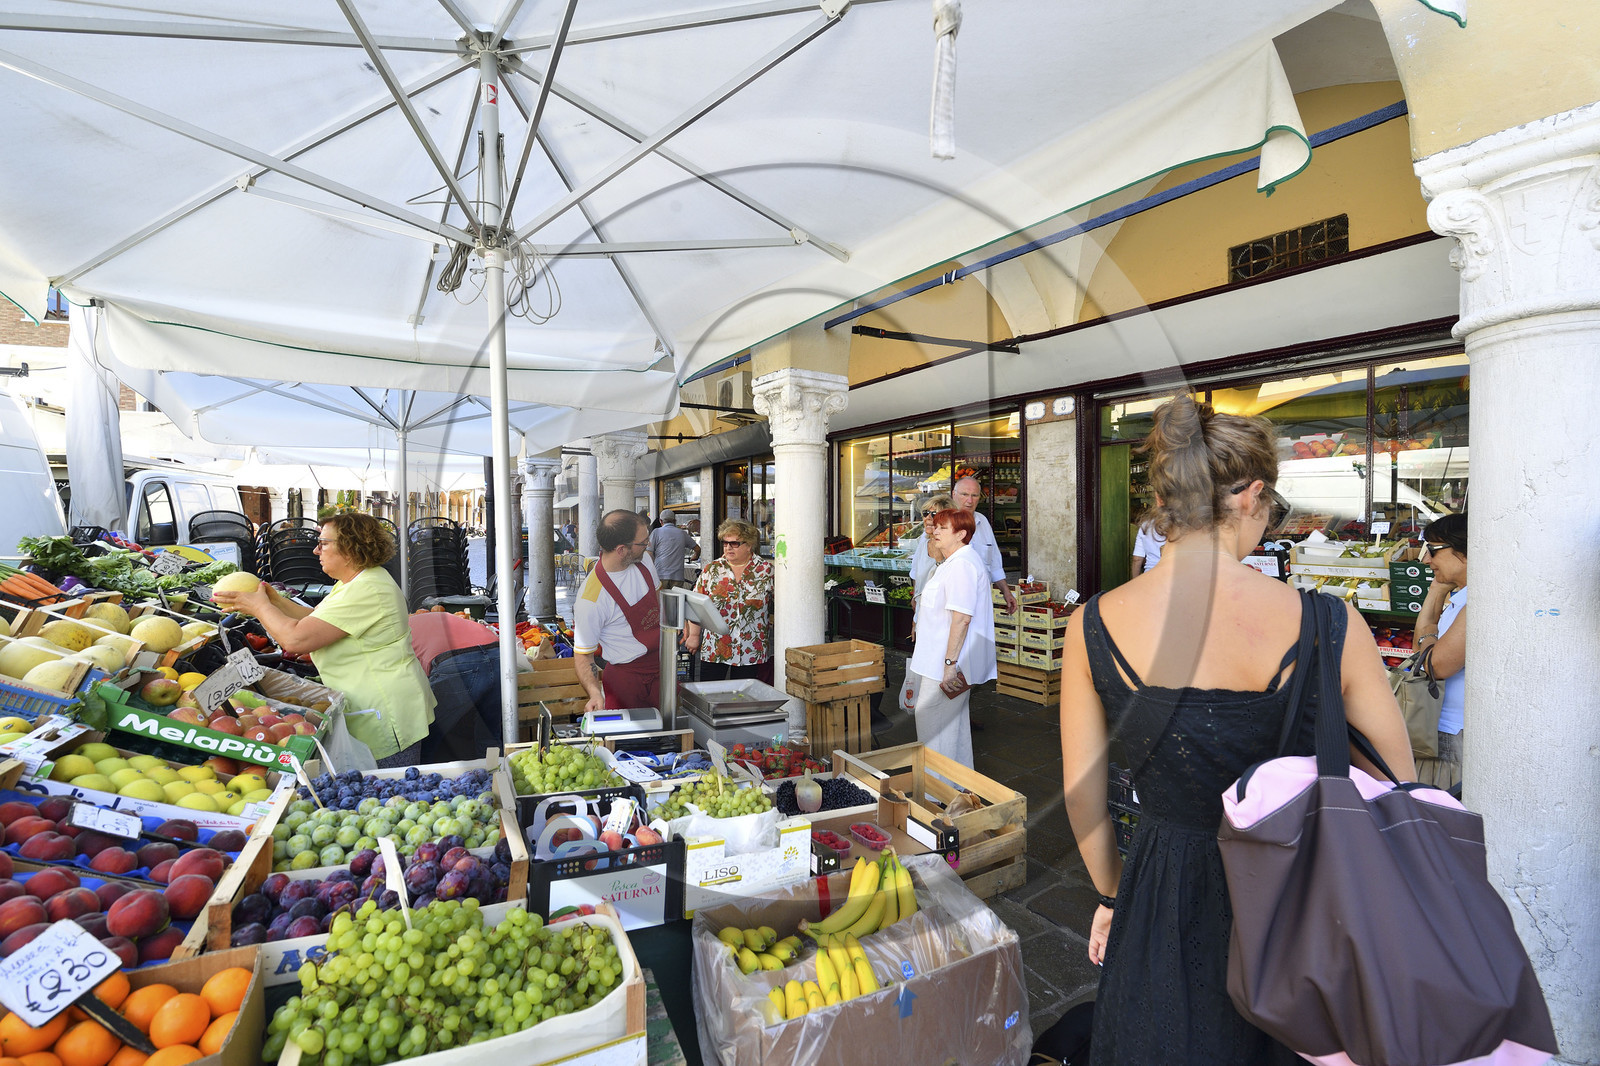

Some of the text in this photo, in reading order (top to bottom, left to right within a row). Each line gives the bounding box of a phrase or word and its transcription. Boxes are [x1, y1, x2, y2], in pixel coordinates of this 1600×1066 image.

[118, 713, 277, 764] MelaPiù
[704, 865, 739, 880] LISO
[601, 885, 660, 904] SATURNIA
